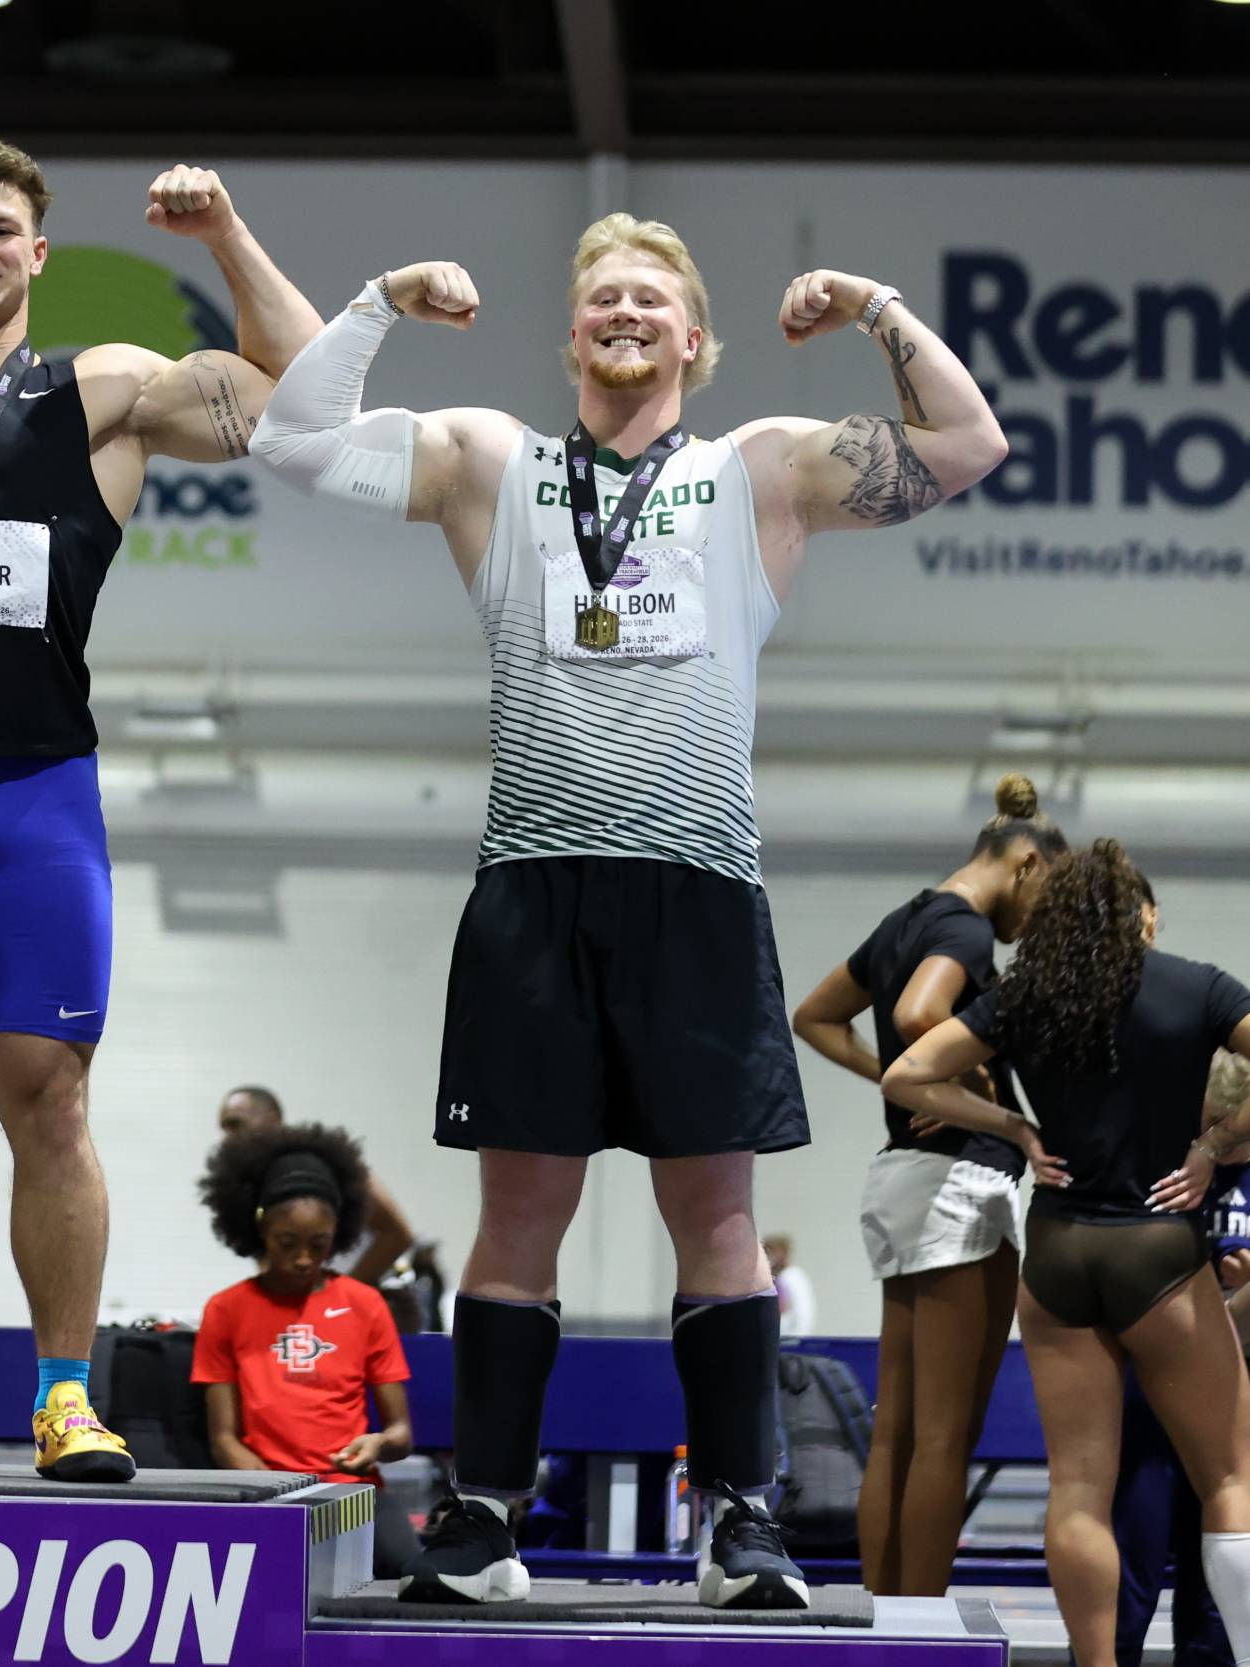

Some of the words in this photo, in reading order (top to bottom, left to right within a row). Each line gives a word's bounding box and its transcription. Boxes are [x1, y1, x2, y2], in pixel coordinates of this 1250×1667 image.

[941, 250, 1250, 382] Ren
[937, 384, 1250, 511] aho
[109, 524, 262, 571] RACK
[633, 619, 653, 627] STATE
[621, 636, 631, 644] 26
[650, 635, 669, 643] 2026
[625, 646, 655, 654] NEVADA
